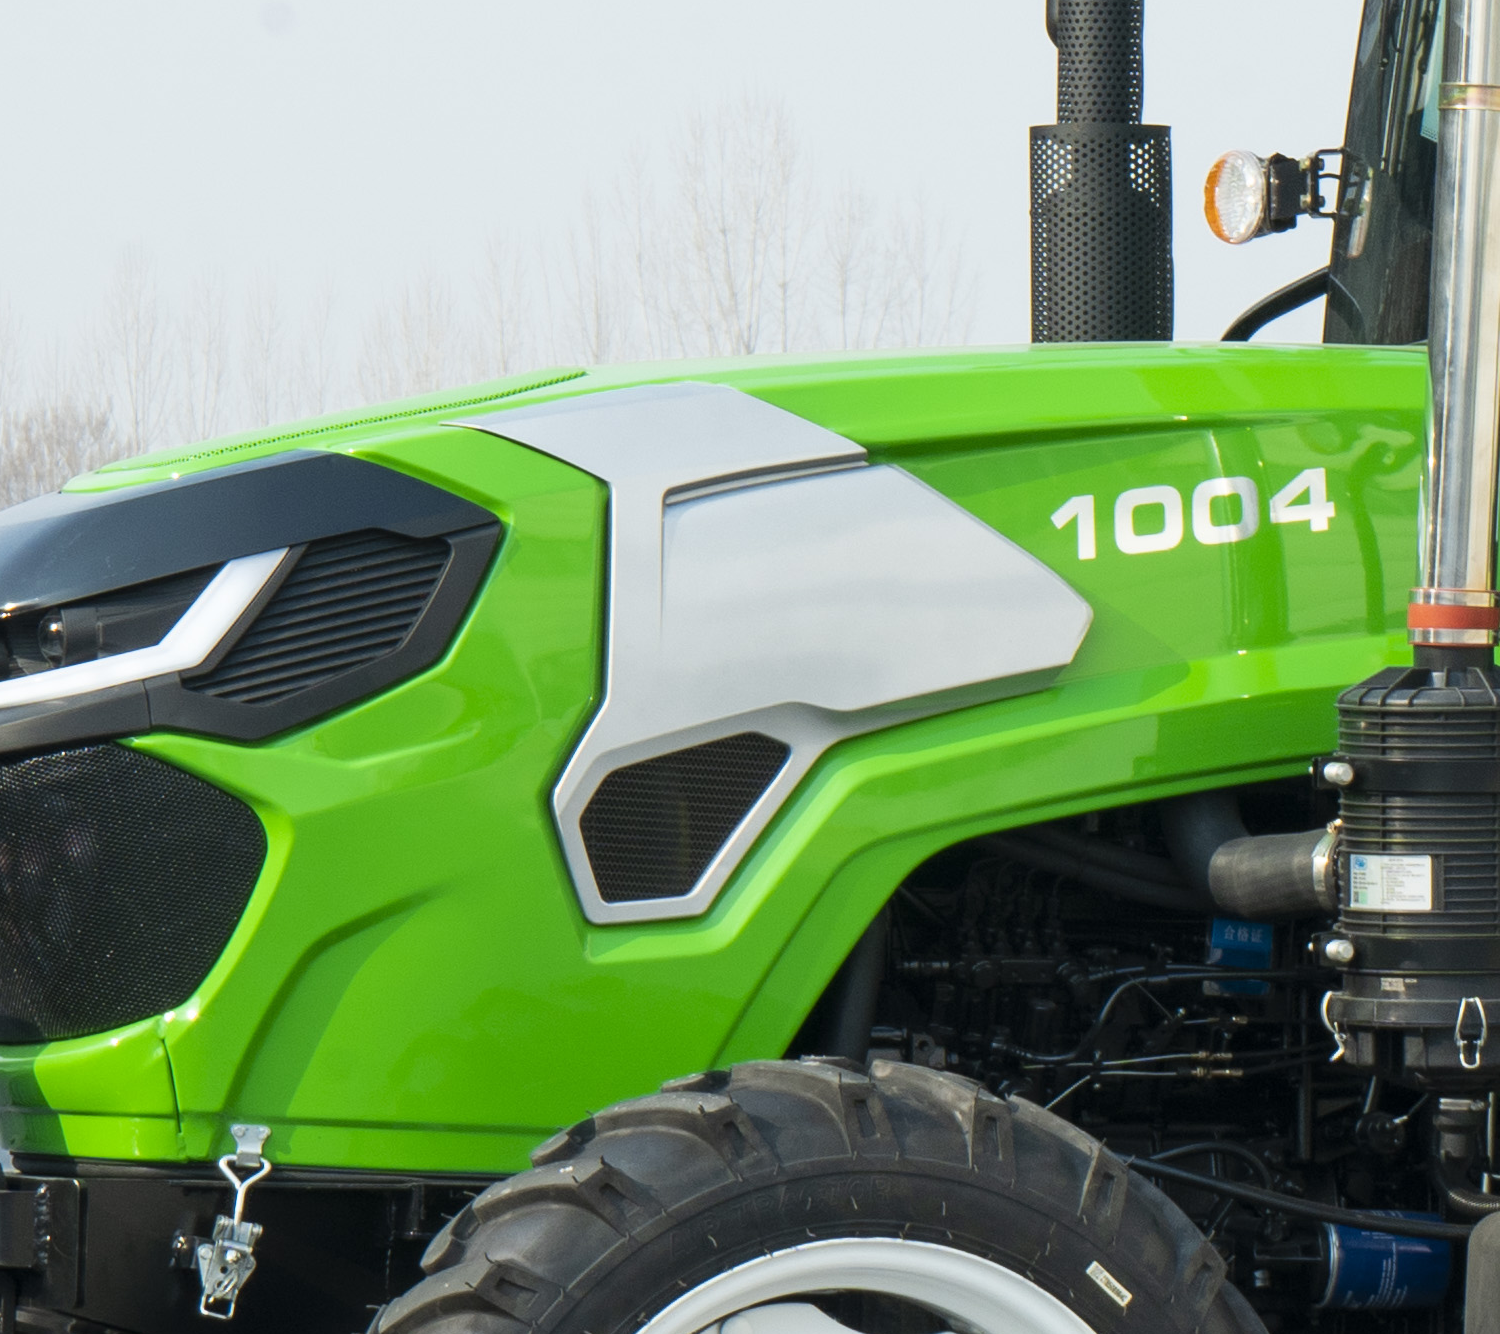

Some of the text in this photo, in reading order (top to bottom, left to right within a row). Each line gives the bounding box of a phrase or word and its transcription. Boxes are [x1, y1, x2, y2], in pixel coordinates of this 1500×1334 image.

[1051, 468, 1335, 560] 1004
[1225, 924, 1263, 943] 合格证
